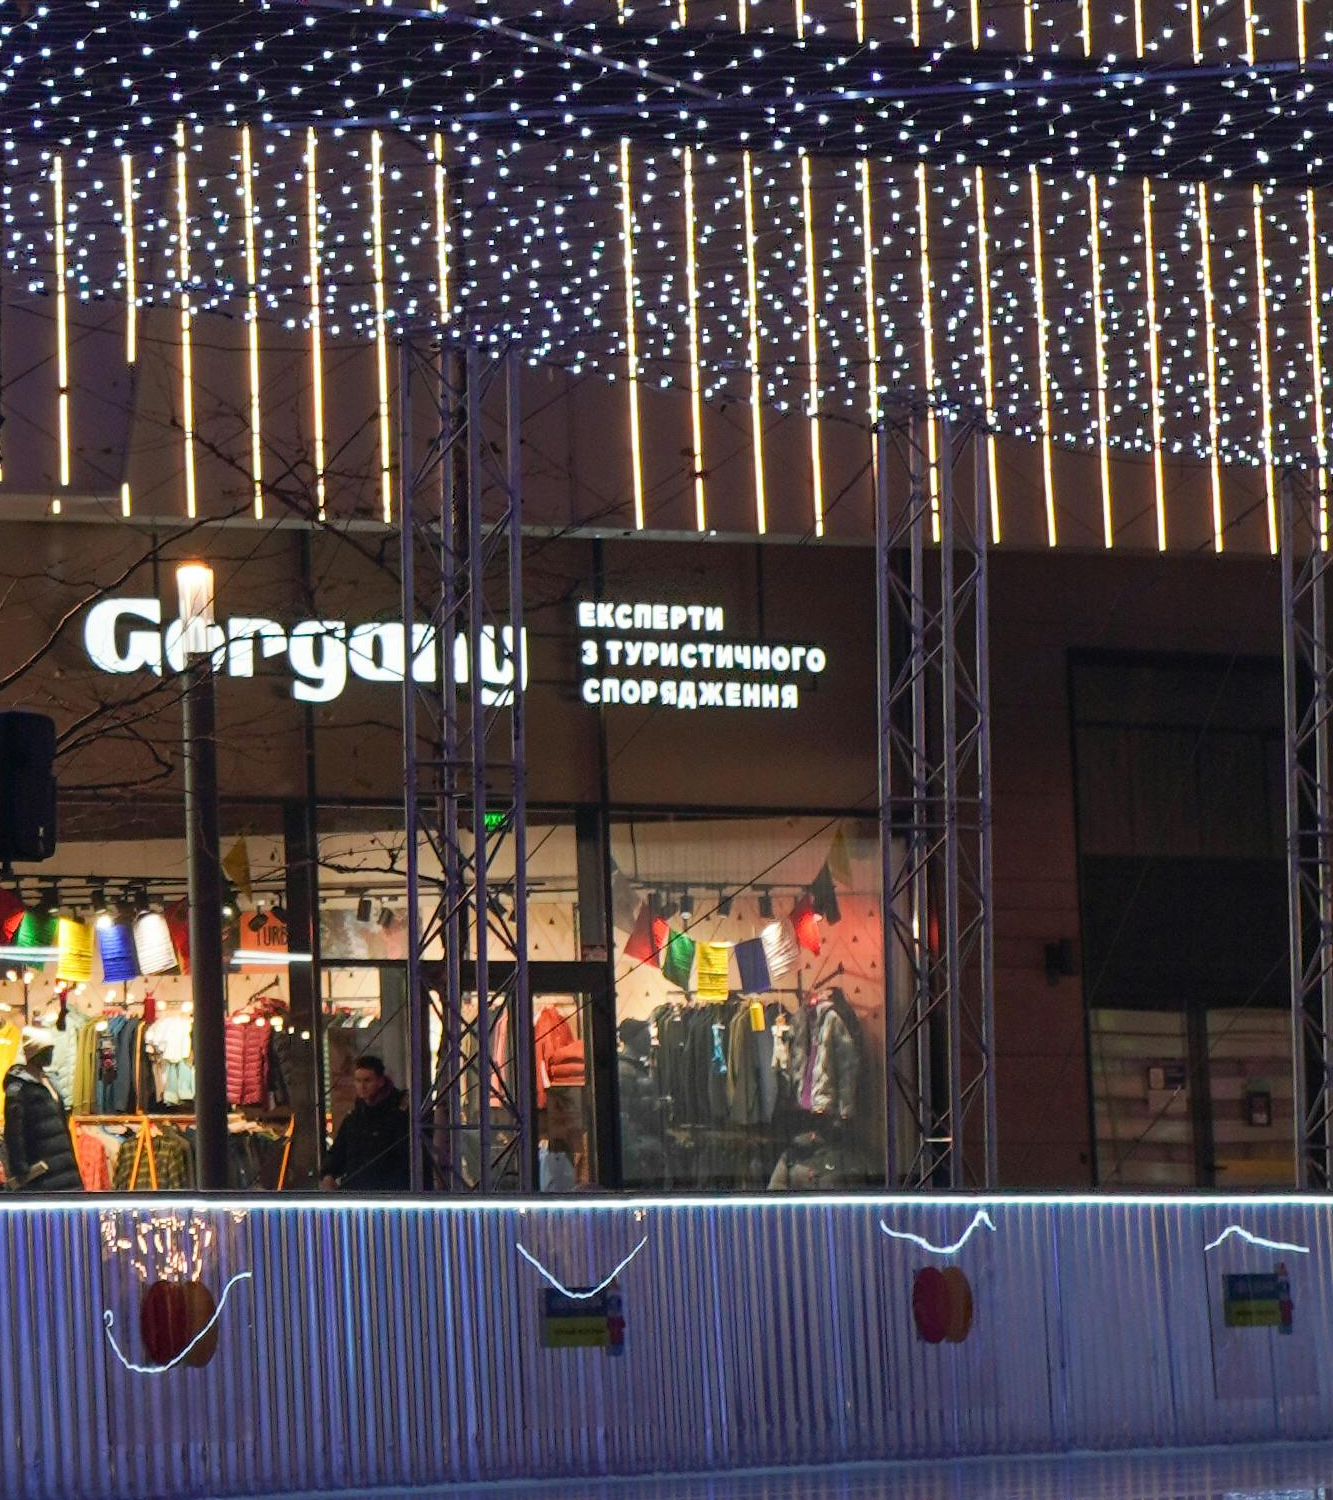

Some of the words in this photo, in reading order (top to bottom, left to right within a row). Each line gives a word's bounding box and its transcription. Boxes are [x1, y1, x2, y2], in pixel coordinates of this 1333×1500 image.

[578, 602, 724, 631] ЕКСПЕРТИ
[606, 640, 827, 673] ТУРИСТИЧНОГО
[583, 678, 799, 709] СПОРЯДЖЕННЯ
